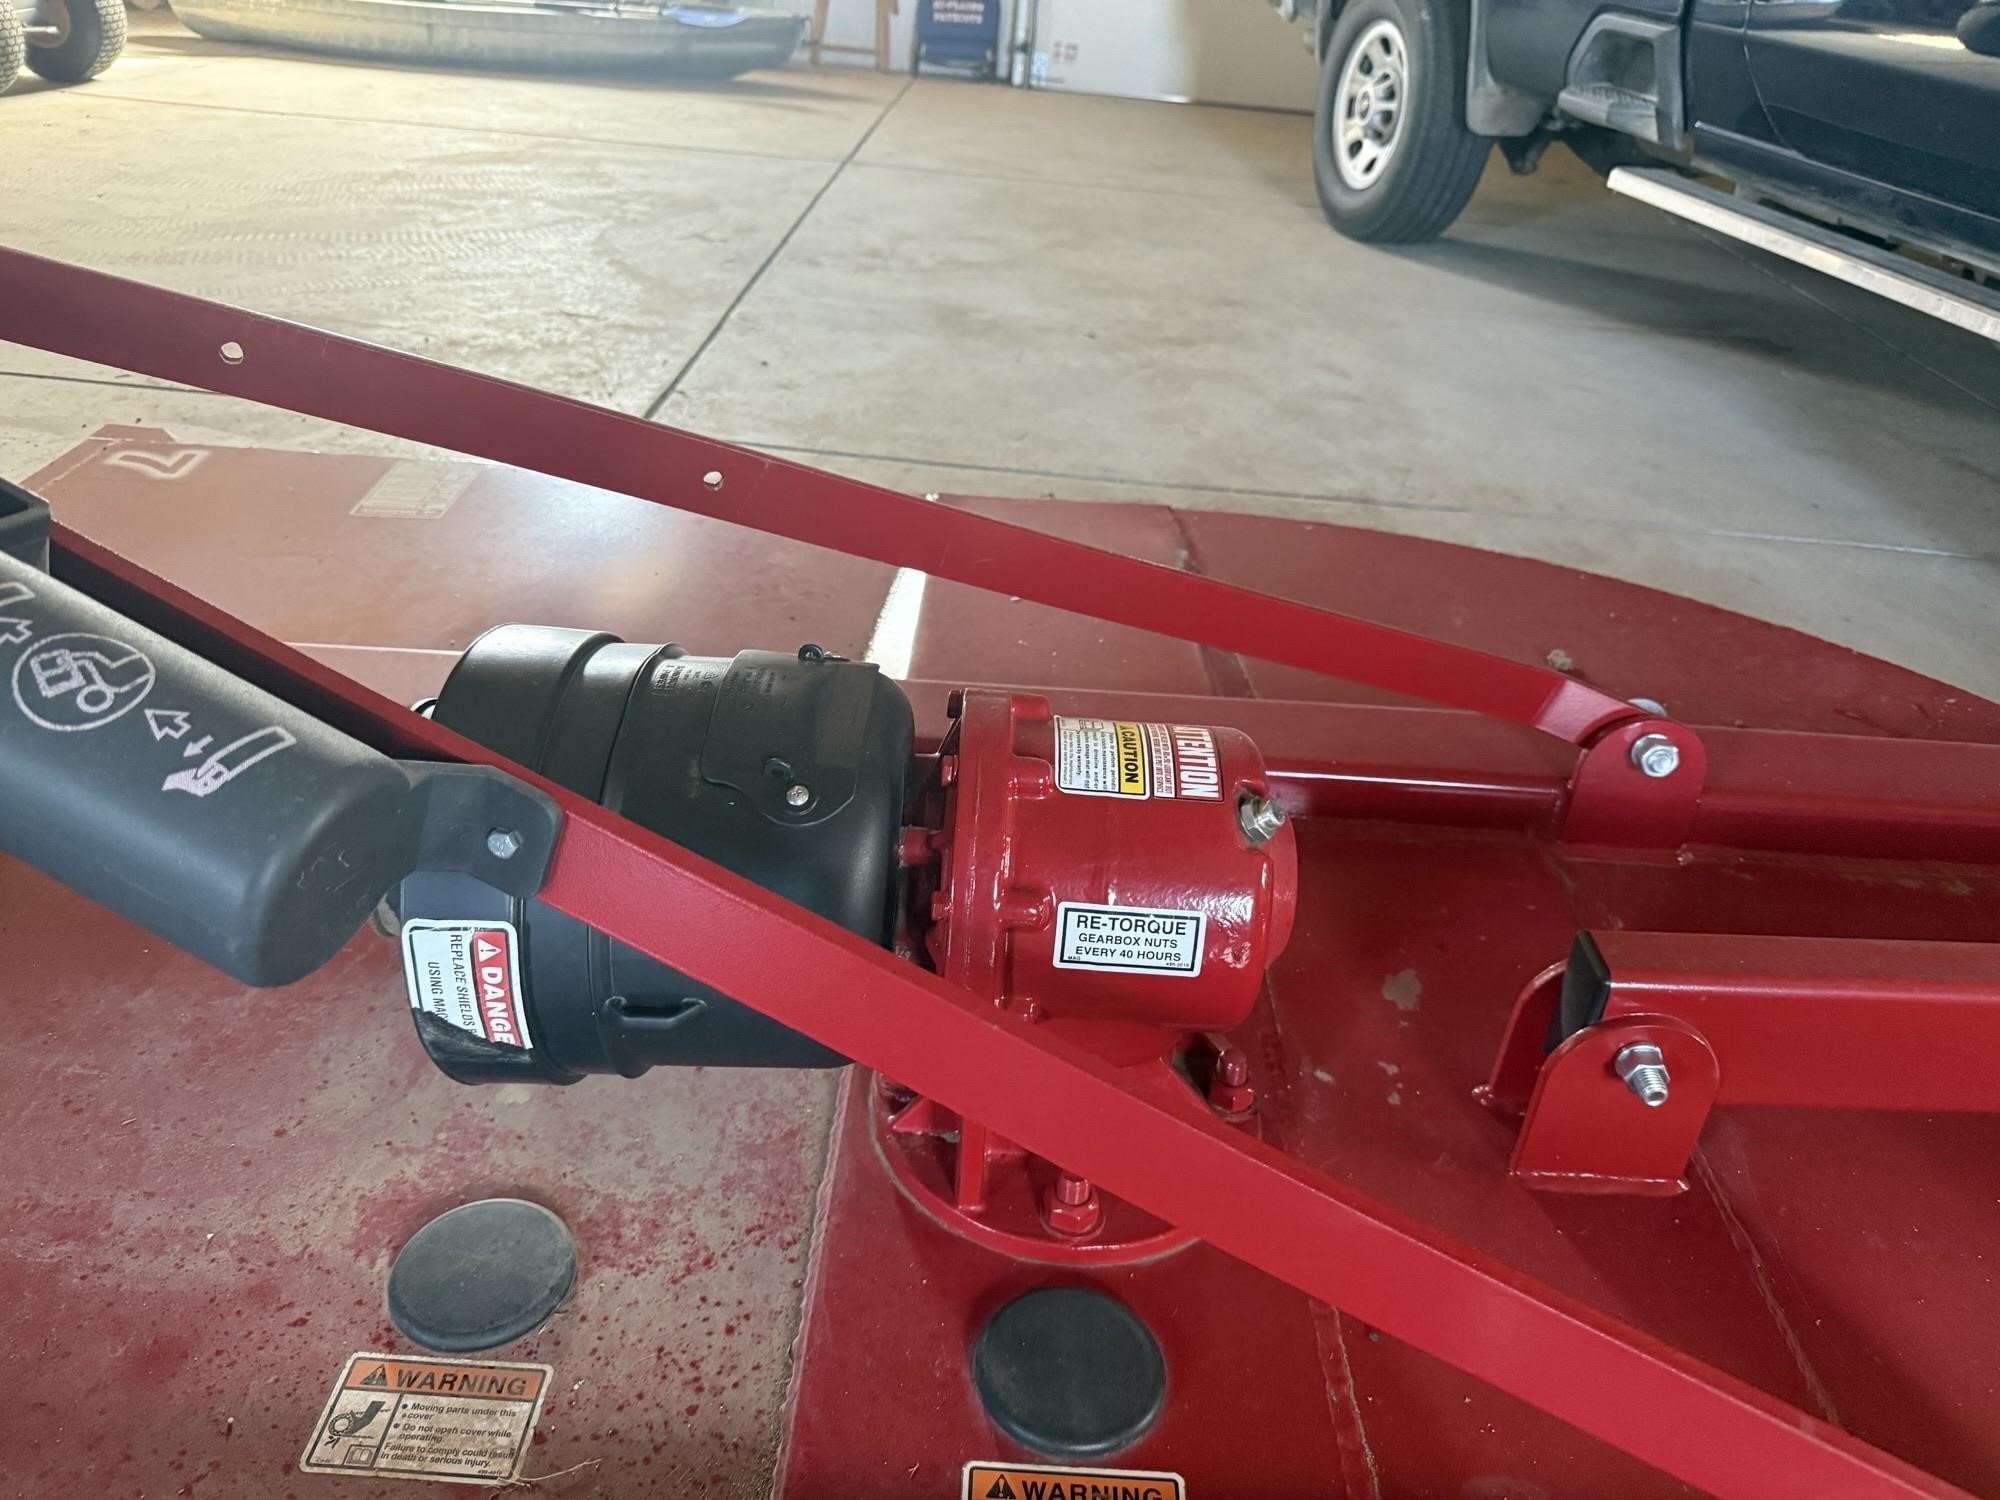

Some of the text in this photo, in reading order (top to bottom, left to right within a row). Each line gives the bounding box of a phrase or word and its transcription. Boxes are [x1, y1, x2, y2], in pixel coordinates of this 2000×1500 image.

[1122, 731, 1139, 783] CAUTION
[1172, 726, 1219, 797] ATTENTION
[1076, 914, 1187, 936] RE-TORQUE
[1078, 933, 1178, 949] GEARBOX NUTS
[450, 934, 466, 984] REPLACE
[1075, 946, 1182, 963] EVERY 40 HOURS
[428, 961, 444, 995] USING
[456, 985, 476, 1026] SHIELDS
[396, 1369, 527, 1396] WARNING
[411, 1402, 517, 1417] Moving parts under this
[460, 1428, 486, 1436] cover
[487, 1429, 512, 1438] while
[383, 1442, 415, 1452] Failure
[416, 1445, 426, 1453] to
[427, 1447, 461, 1456] comply
[462, 1448, 488, 1457] could
[430, 1456, 463, 1465] serious
[465, 1457, 491, 1468] injury.
[1022, 1480, 1162, 1500] WARNING
